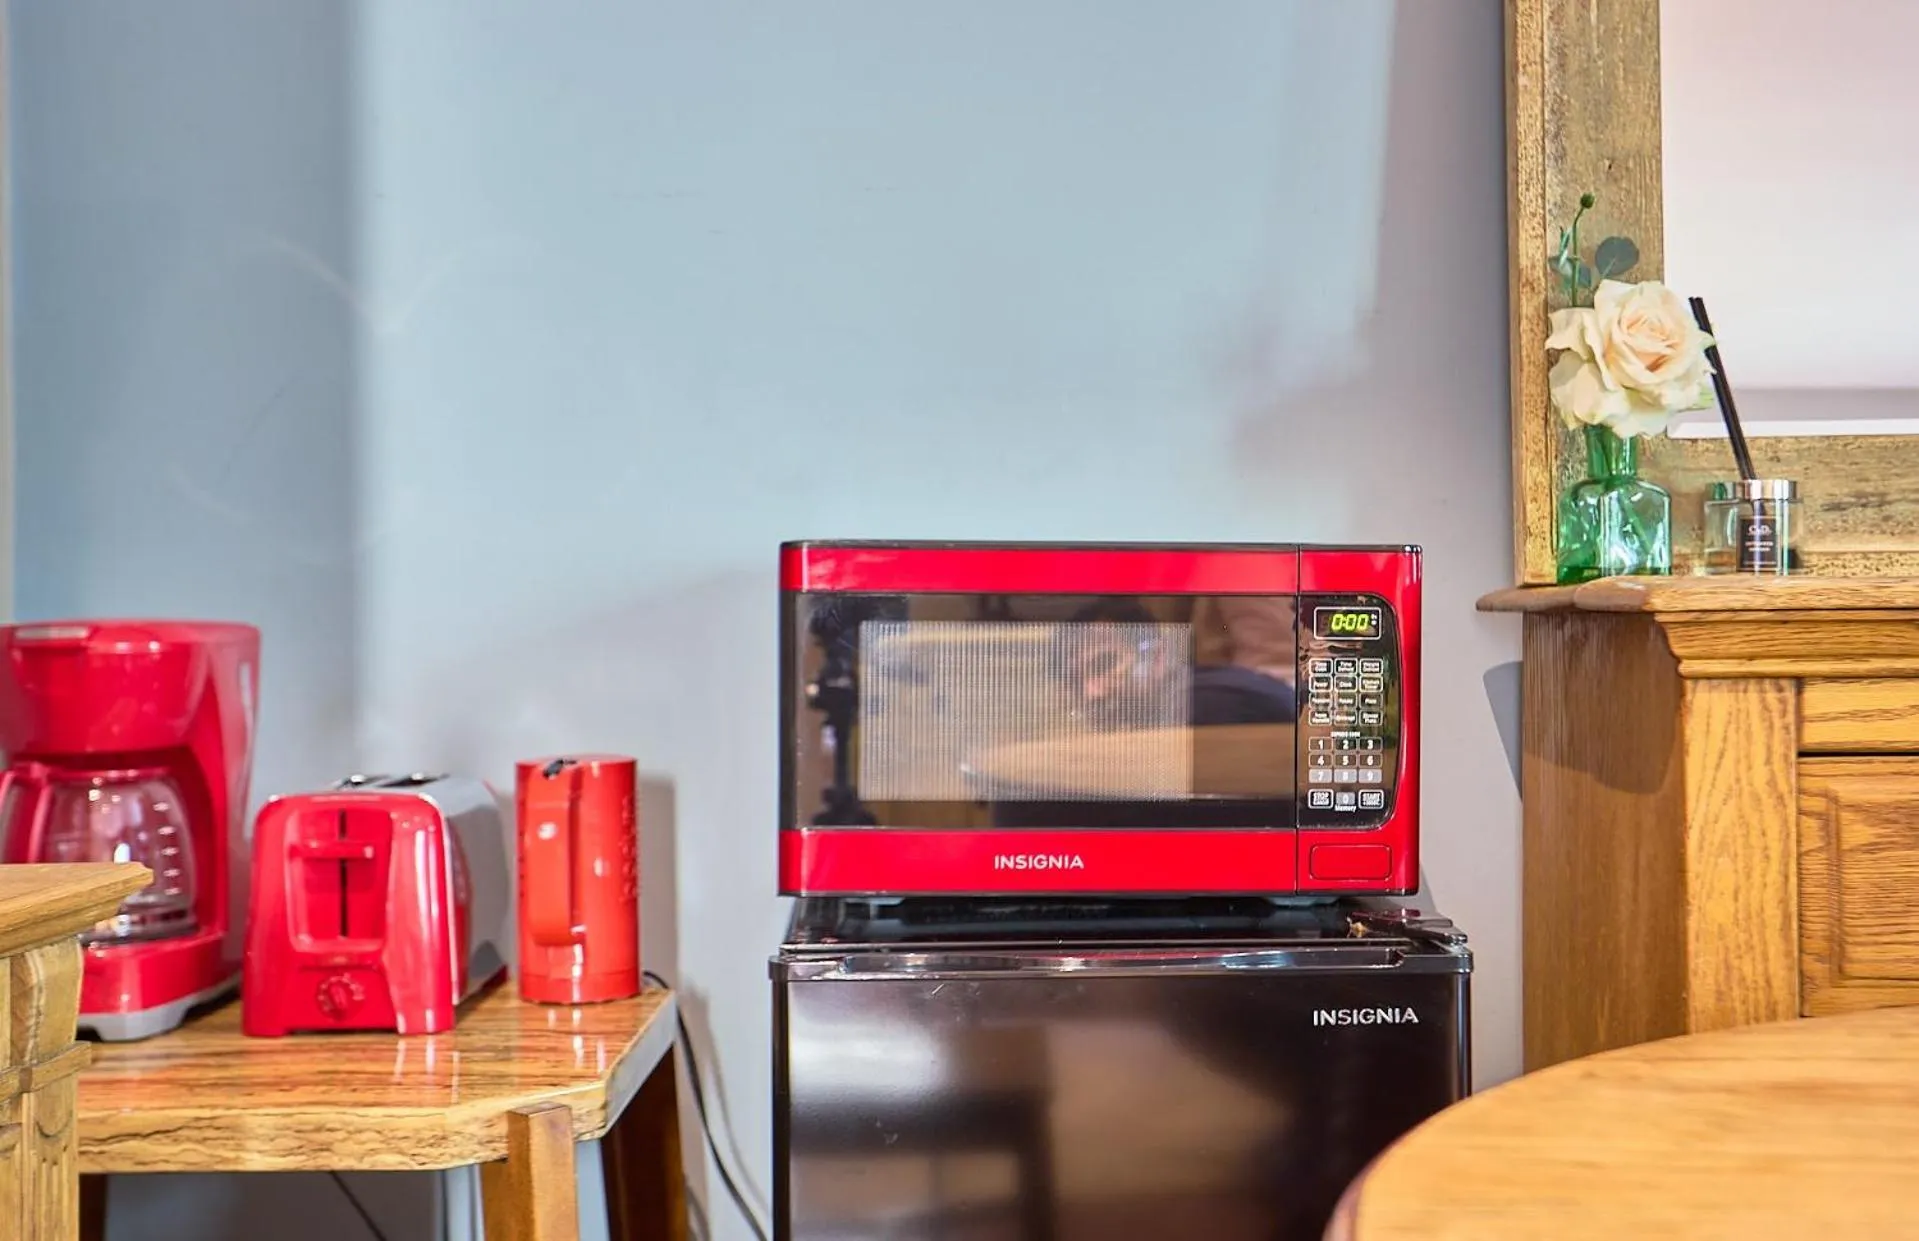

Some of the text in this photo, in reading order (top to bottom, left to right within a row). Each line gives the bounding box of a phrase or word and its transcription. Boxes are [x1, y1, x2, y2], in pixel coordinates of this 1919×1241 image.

[1332, 613, 1369, 631] 0:00
[1318, 740, 1324, 749] 1
[1342, 740, 1349, 749] 2
[1367, 740, 1374, 749] 3
[1318, 756, 1324, 765] 4
[1342, 756, 1349, 765] 5
[1367, 756, 1374, 765] 6
[1318, 771, 1324, 781] 7
[1342, 771, 1349, 781] 8
[1367, 771, 1374, 781] 9
[1335, 805, 1357, 813] Memory
[994, 854, 1085, 870] INSIGNIA
[1313, 1006, 1419, 1026] INSIGNIA
